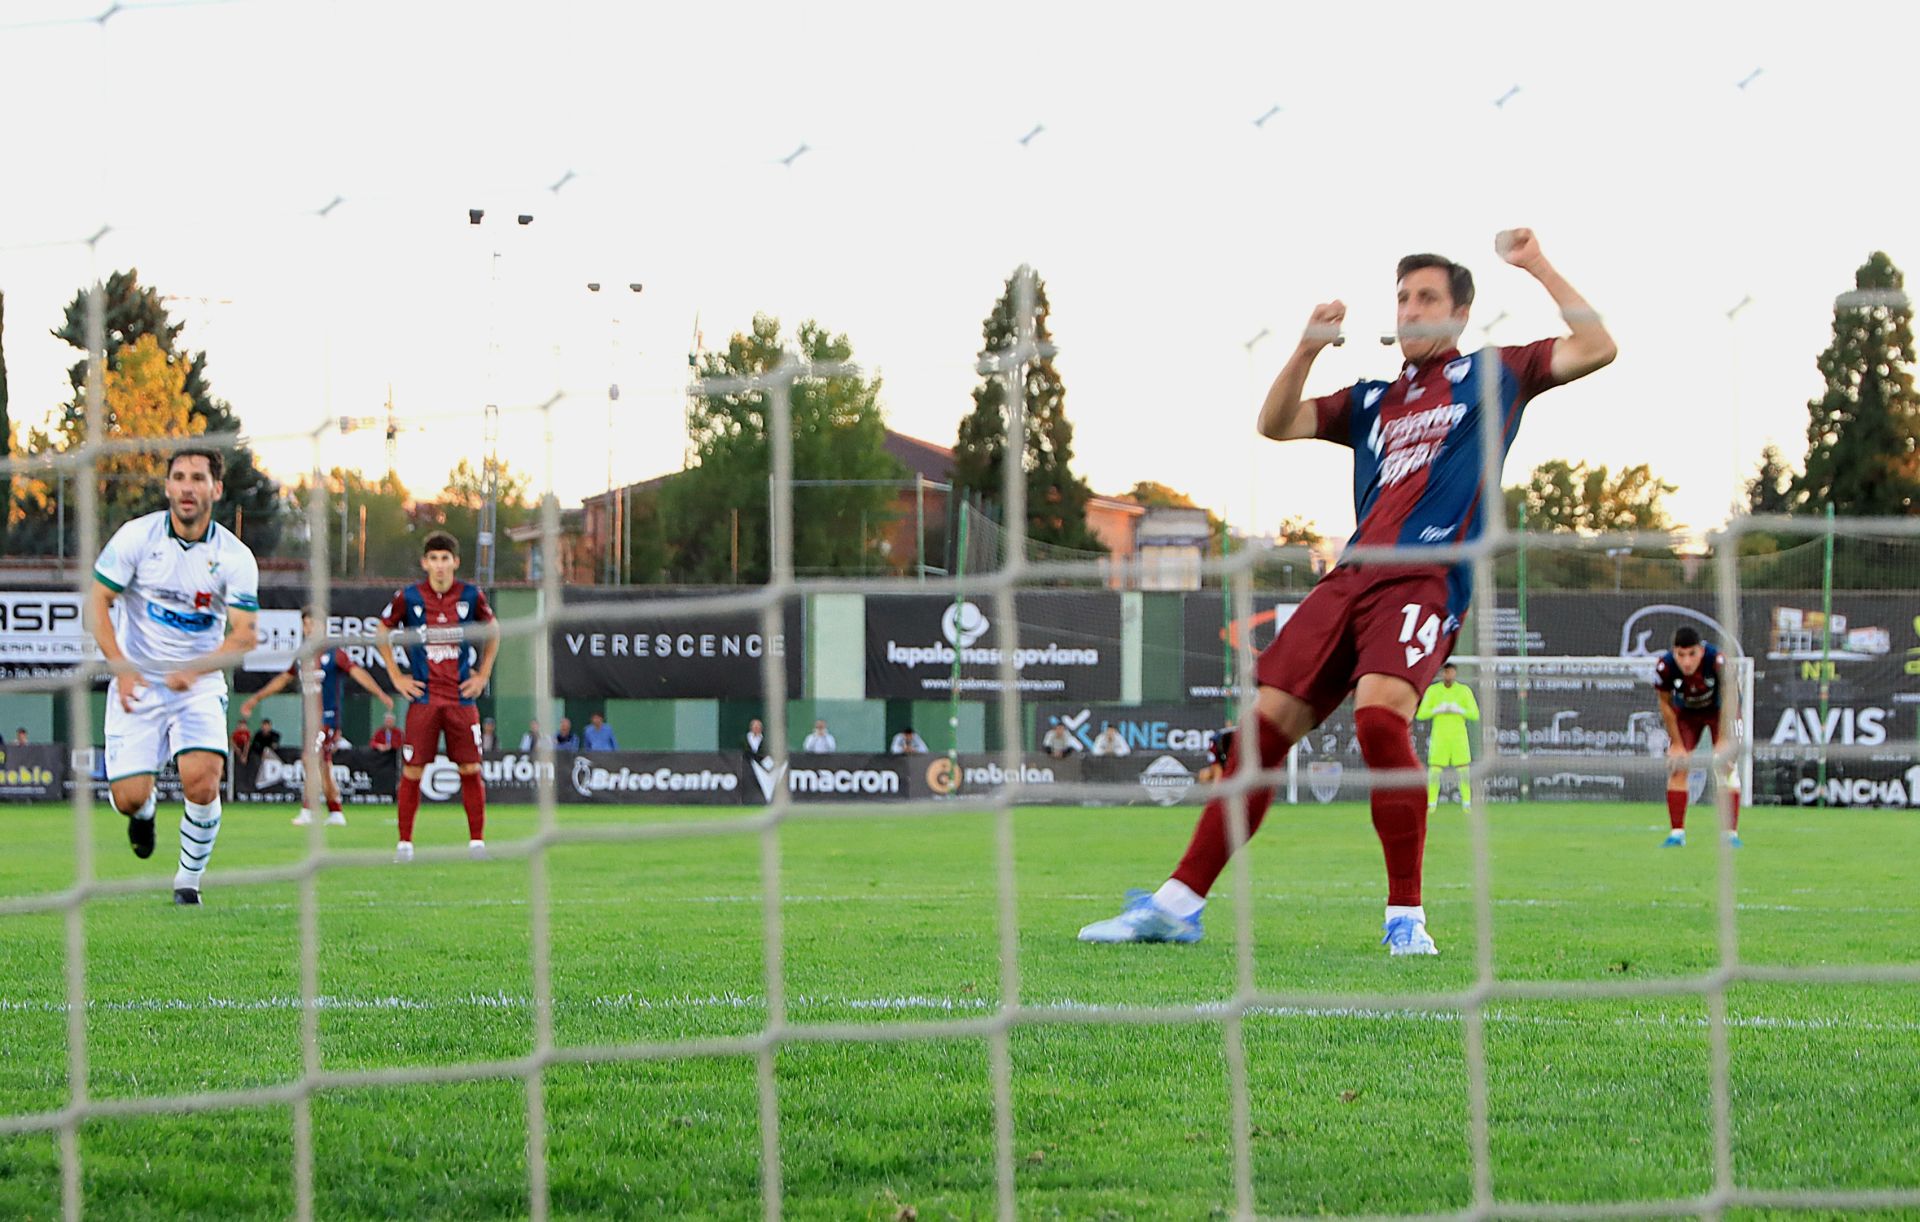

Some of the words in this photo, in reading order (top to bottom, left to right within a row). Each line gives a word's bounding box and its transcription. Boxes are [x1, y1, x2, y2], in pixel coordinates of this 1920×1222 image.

[0, 604, 78, 631] SP
[1398, 603, 1441, 656] 14
[565, 633, 785, 657] VERESCENCE
[1769, 706, 1887, 745] AVIS
[589, 767, 738, 791] BricoCentro
[789, 769, 899, 793] macron
